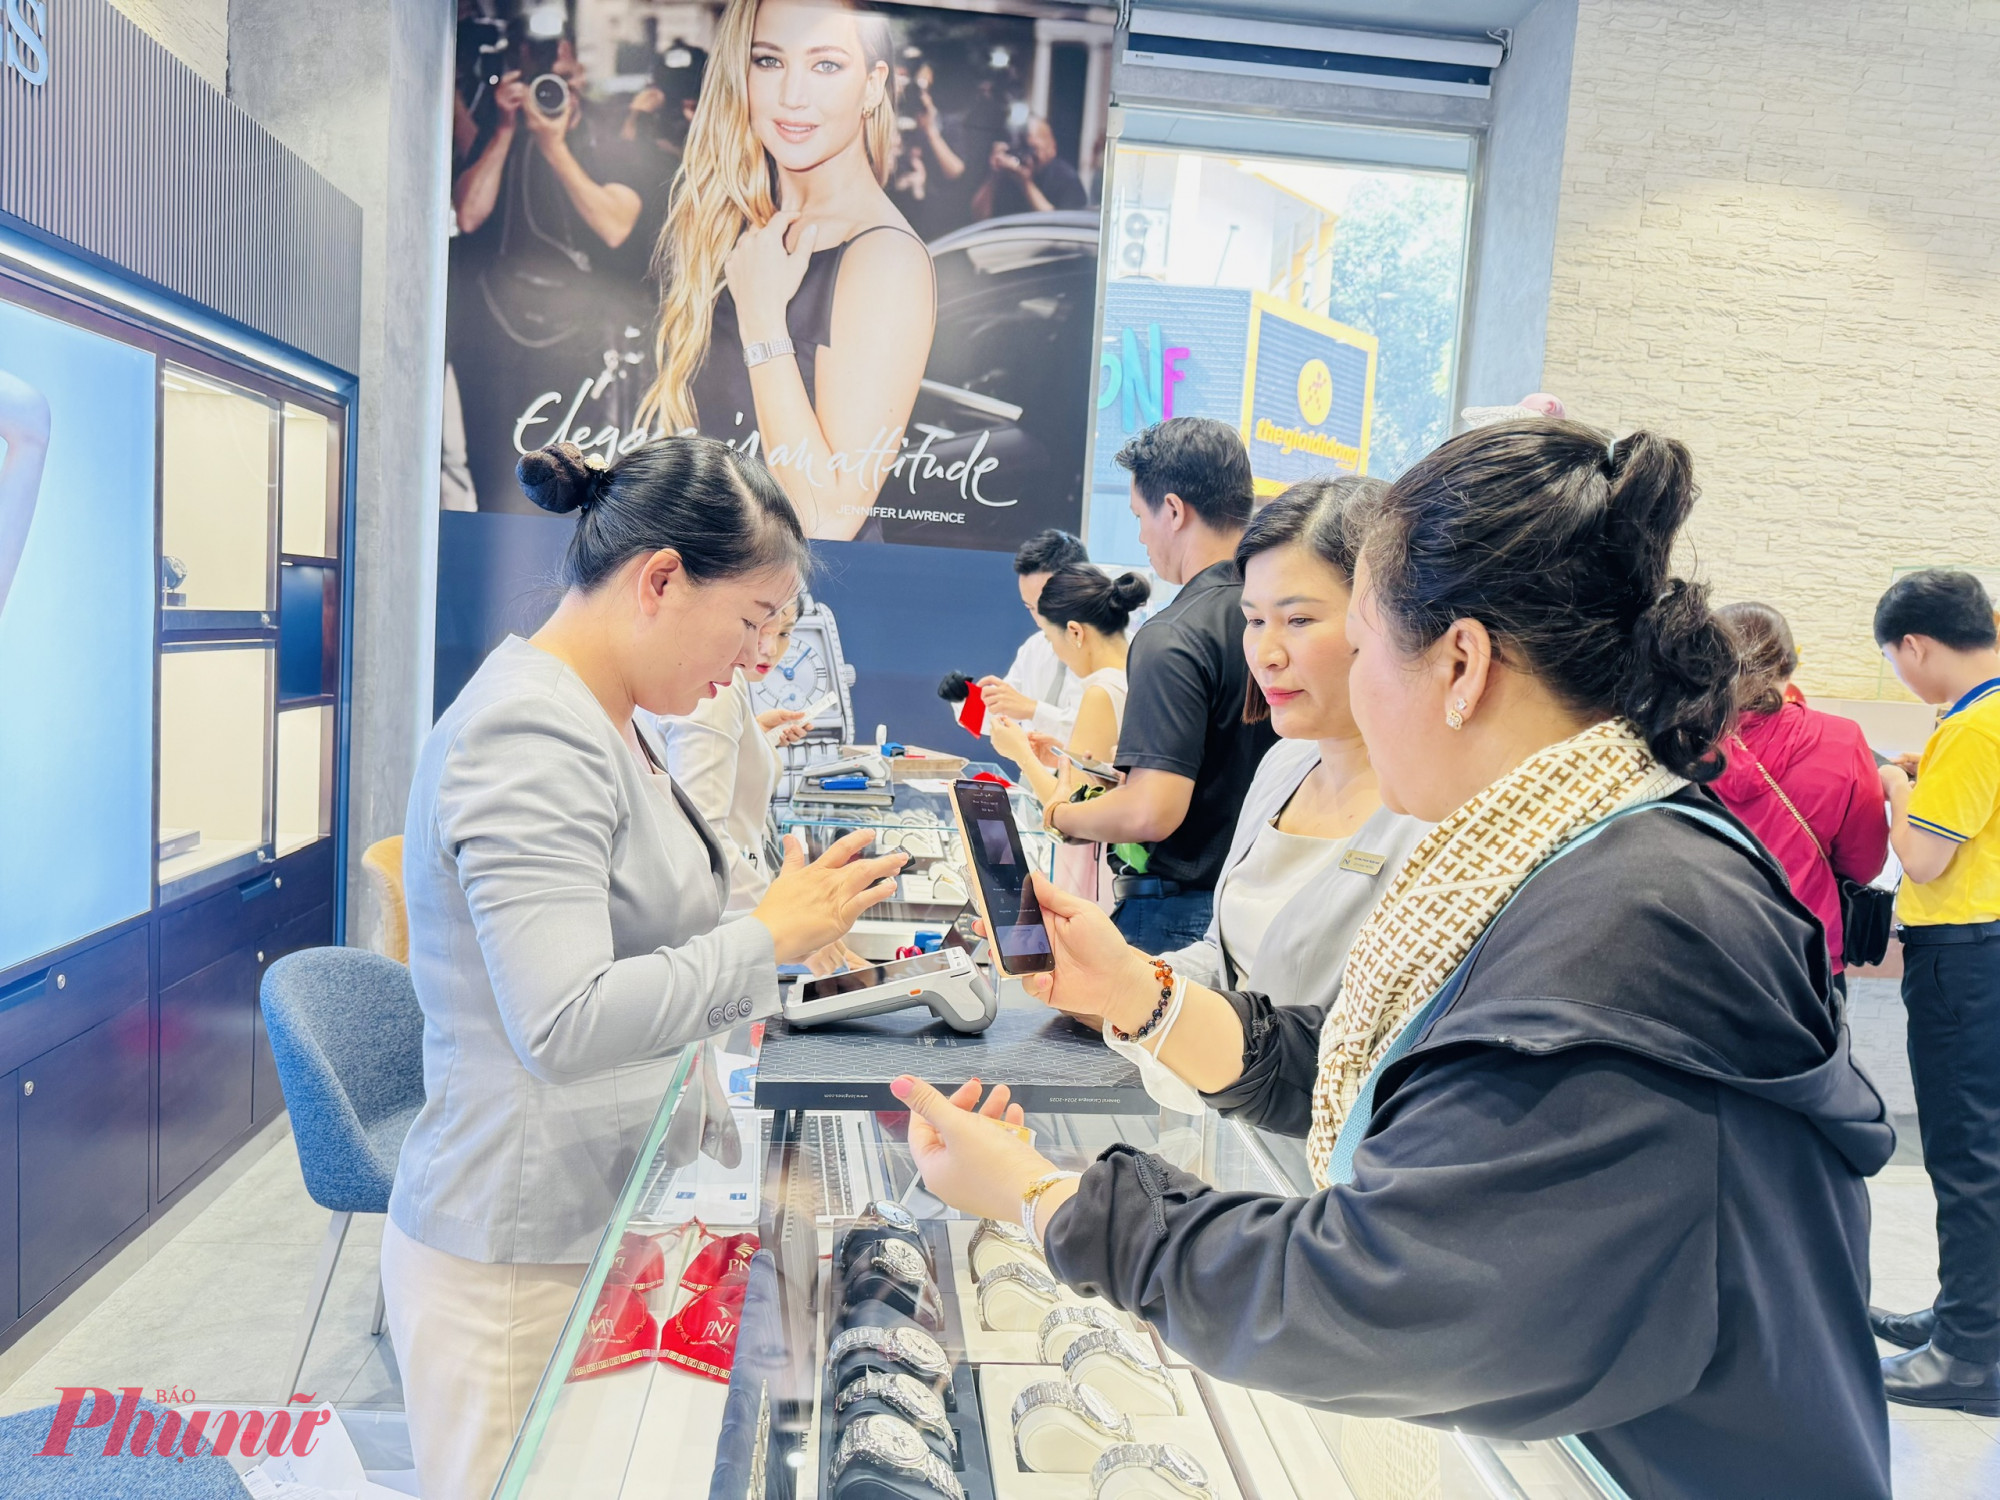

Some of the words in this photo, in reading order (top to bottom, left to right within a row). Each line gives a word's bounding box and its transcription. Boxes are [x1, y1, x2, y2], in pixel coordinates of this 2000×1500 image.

[0, 0, 48, 86] S
[826, 422, 1018, 507] attitude
[836, 503, 897, 519] JENNIFER
[898, 507, 966, 525] LAWRENCE
[728, 1258, 751, 1271] PN
[701, 1319, 736, 1343] PNJ
